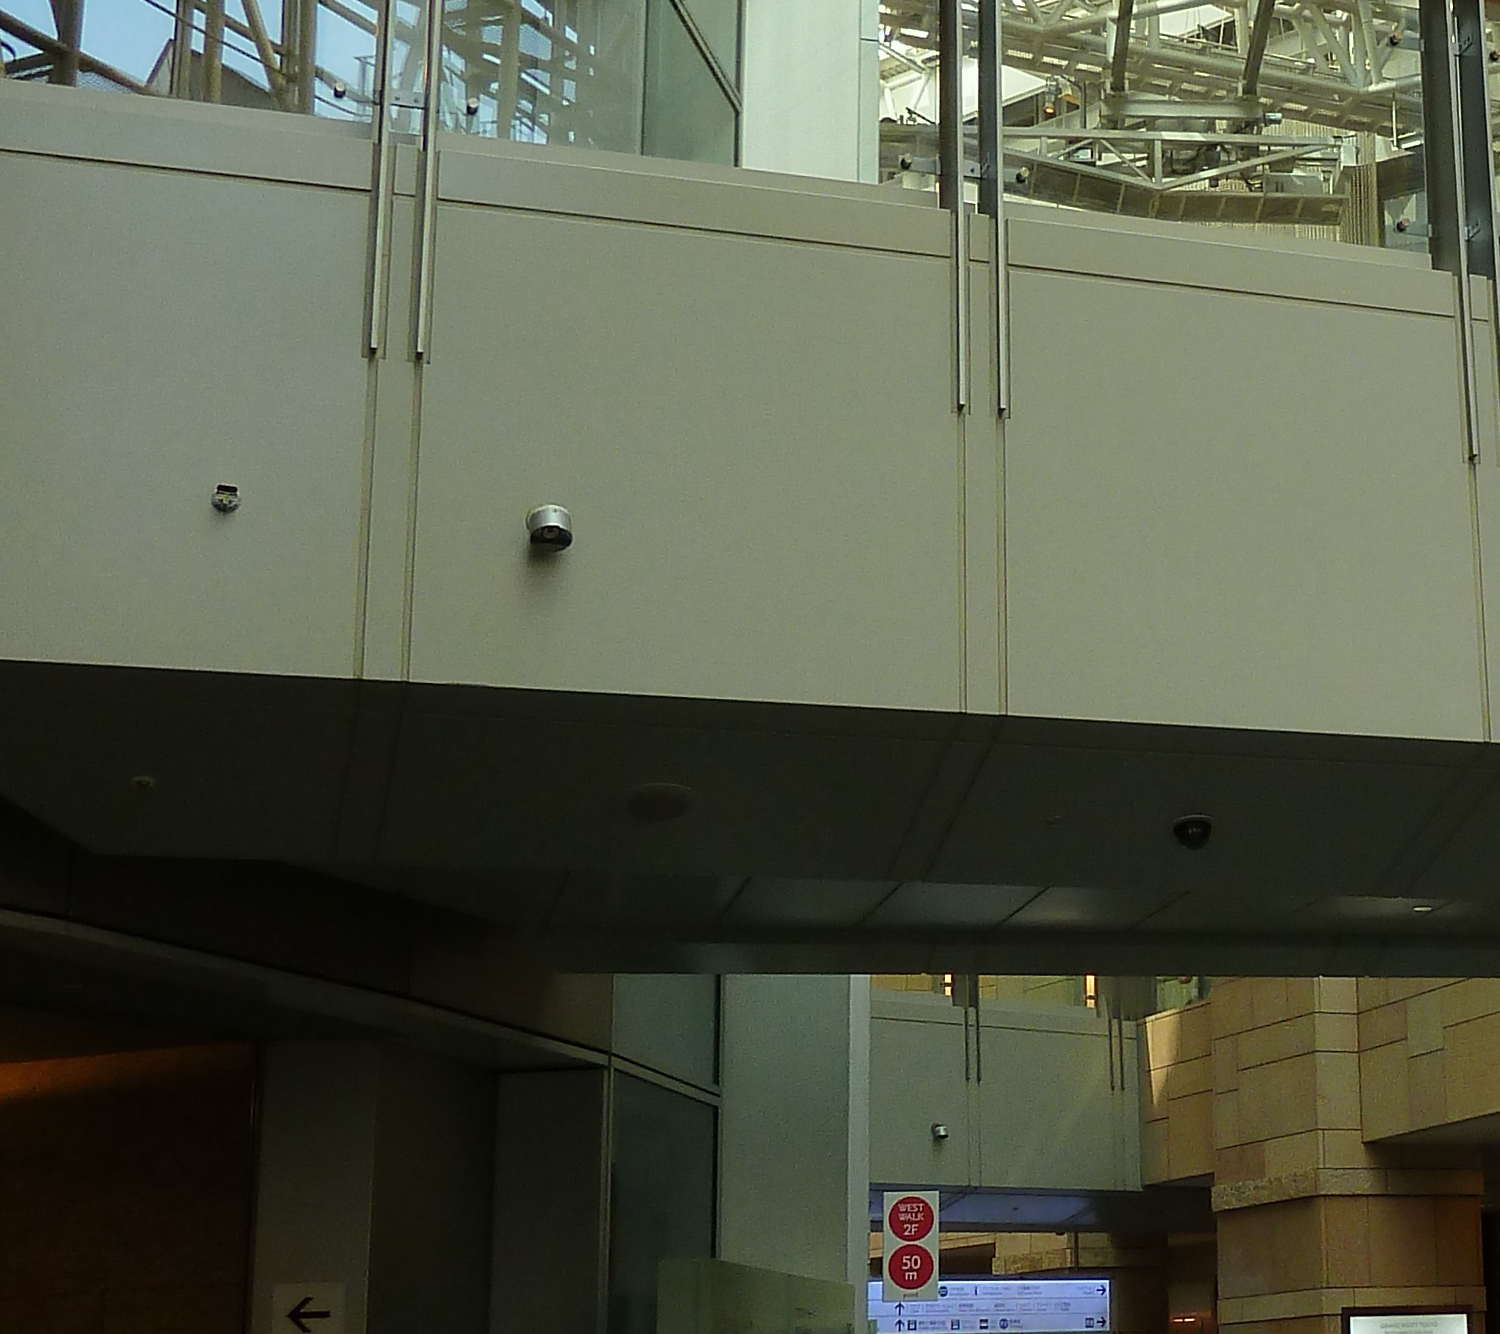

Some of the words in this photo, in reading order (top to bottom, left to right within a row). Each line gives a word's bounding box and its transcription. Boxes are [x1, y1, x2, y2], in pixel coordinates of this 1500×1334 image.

[898, 1203, 924, 1212] WEST
[898, 1213, 925, 1221] WALK
[903, 1224, 919, 1235] 2F
[901, 1255, 921, 1270] 50
[905, 1272, 917, 1280] m
